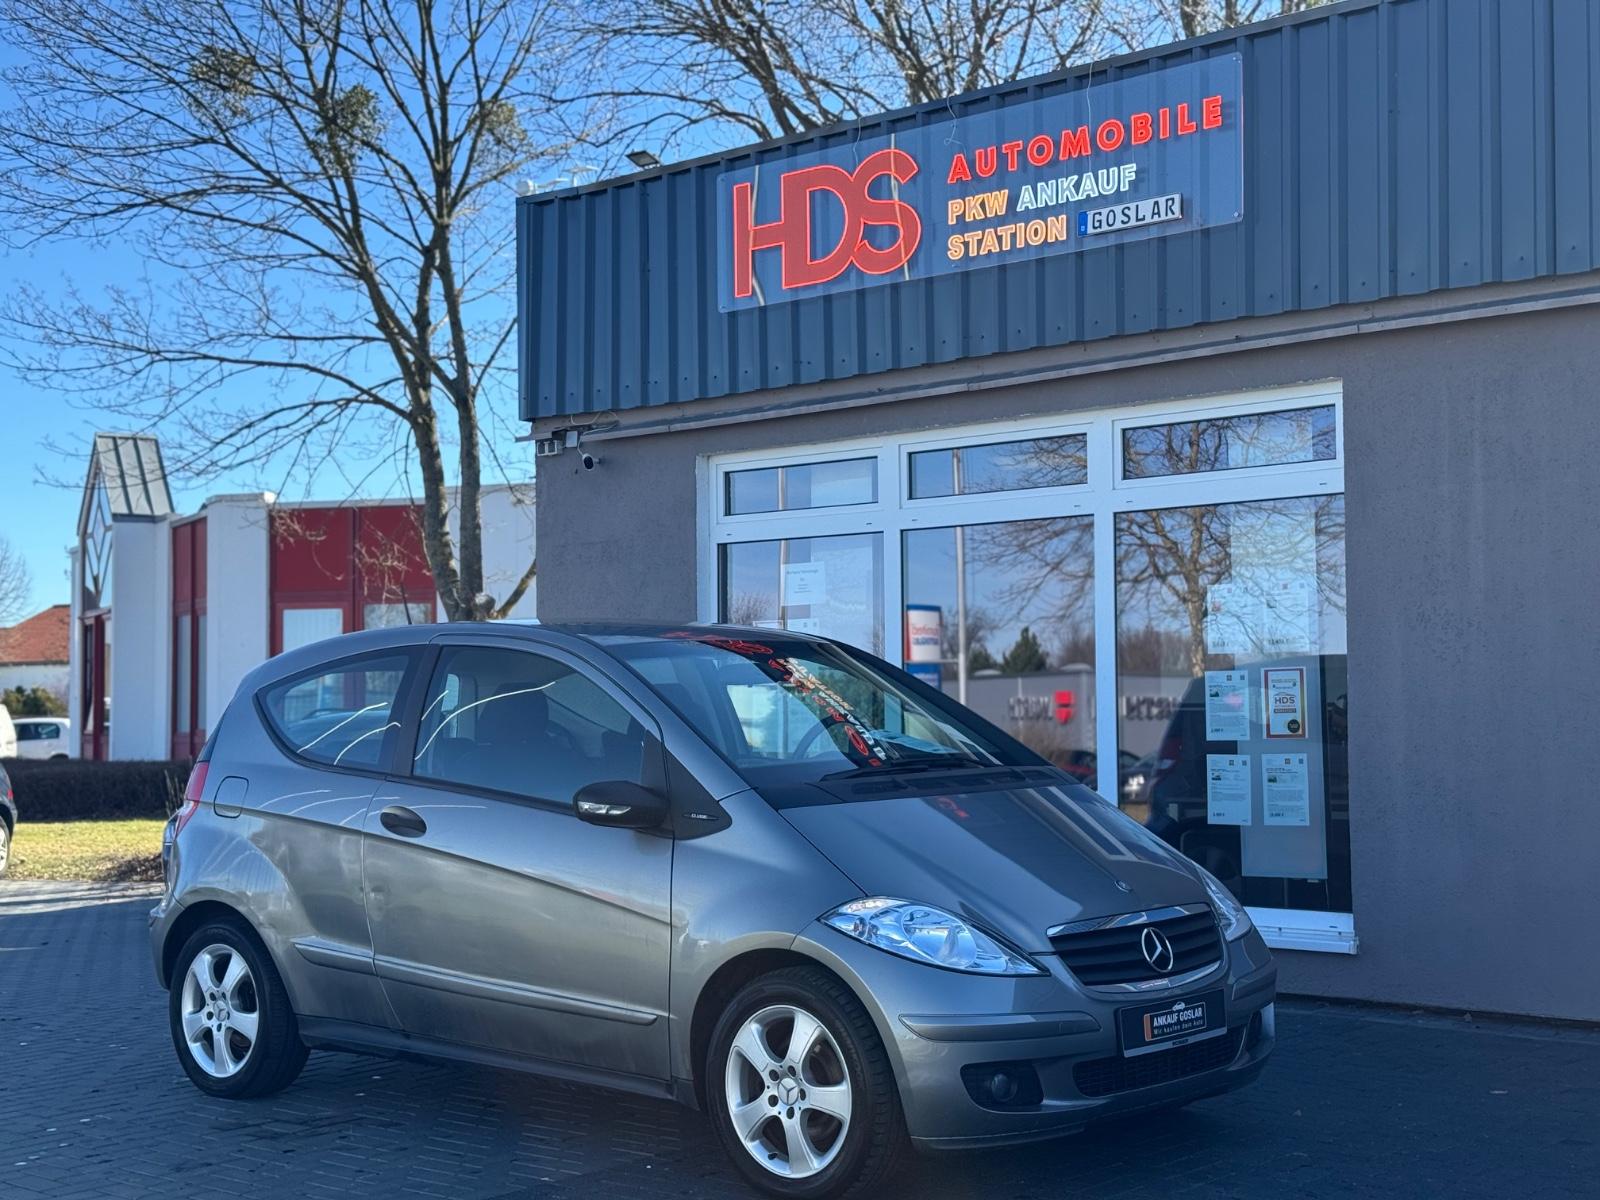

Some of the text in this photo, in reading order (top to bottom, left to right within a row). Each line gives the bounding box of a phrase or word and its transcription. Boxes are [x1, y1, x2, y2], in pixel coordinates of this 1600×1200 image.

[947, 95, 1222, 184] AUTOMOBILE
[733, 148, 922, 298] HDS
[948, 163, 1137, 225] PKW ANKAUF
[947, 197, 1176, 260] STATION GOSLAR
[1274, 696, 1296, 704] HDS
[1153, 1007, 1202, 1027] ANKAUF GOSLAR
